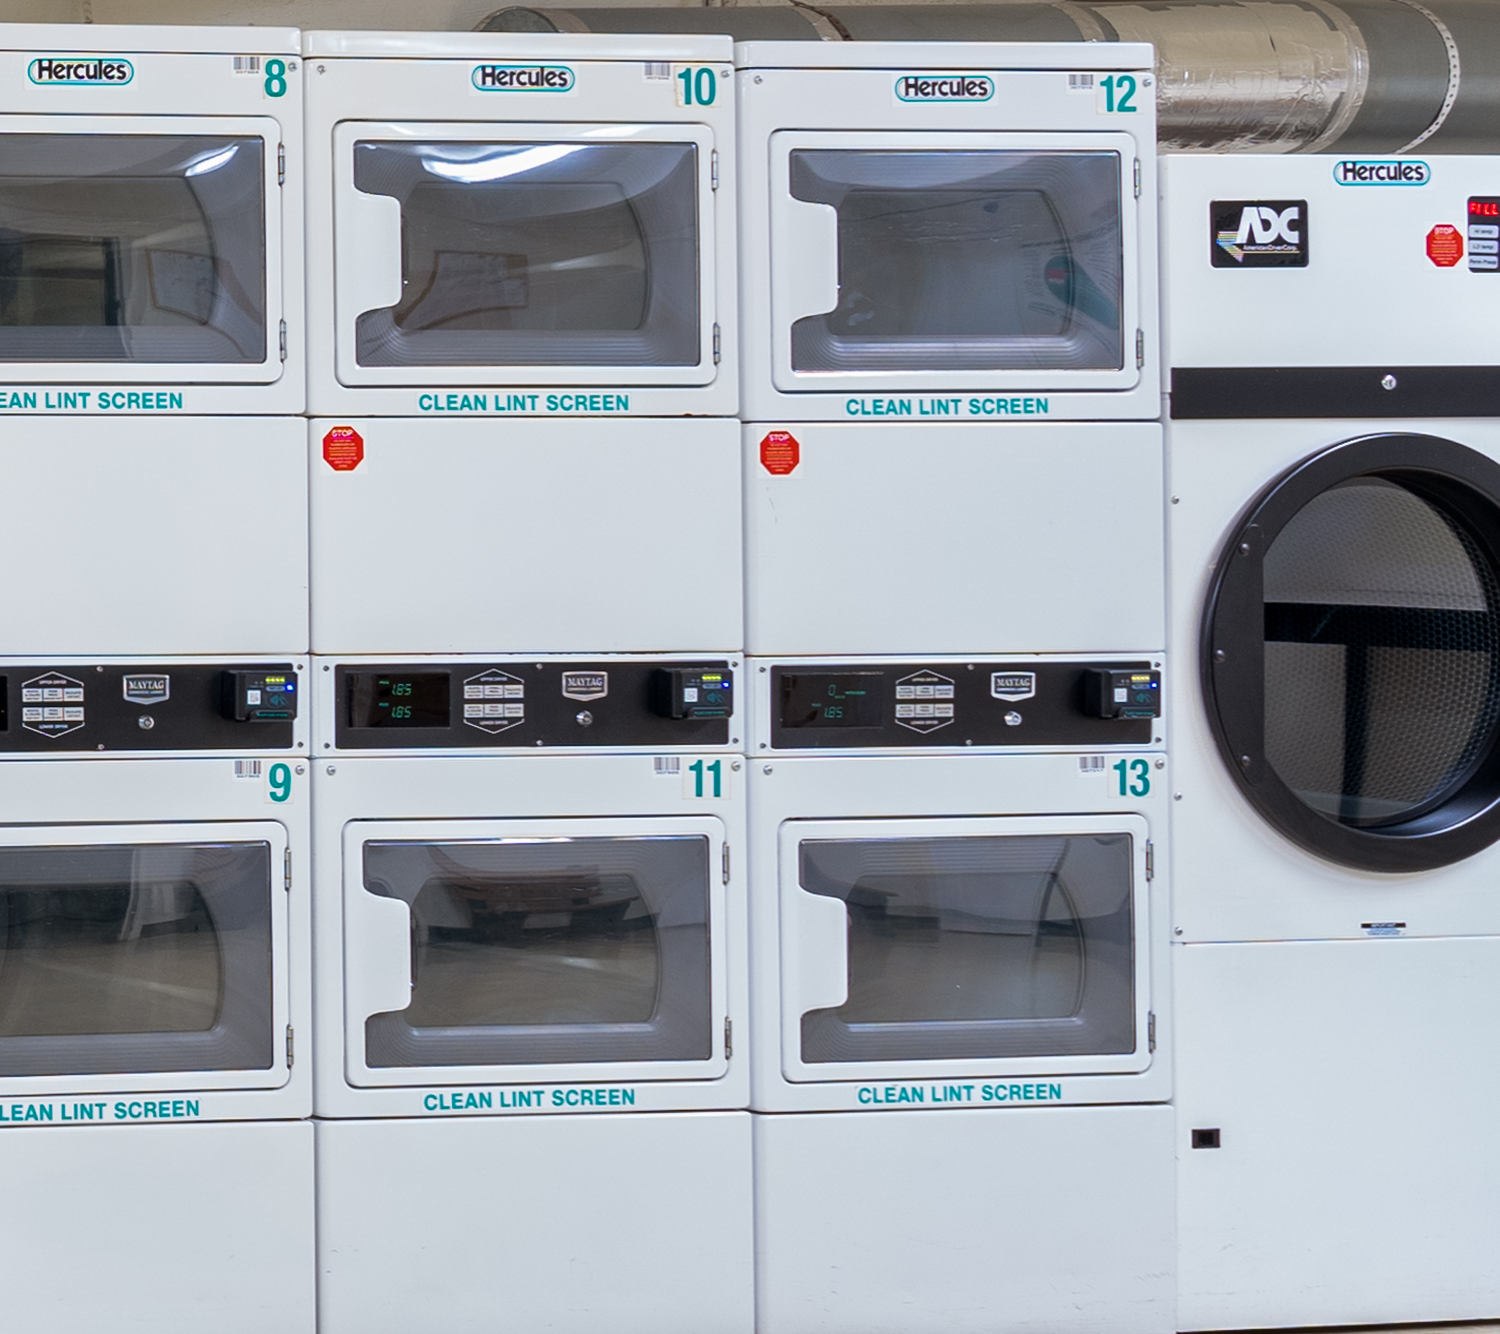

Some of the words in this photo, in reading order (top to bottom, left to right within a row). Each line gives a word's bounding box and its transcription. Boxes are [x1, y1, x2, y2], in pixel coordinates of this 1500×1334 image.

[38, 59, 127, 80] Hercules
[265, 58, 287, 98] 8
[481, 65, 568, 87] Hercules
[678, 67, 716, 106] 10
[904, 76, 988, 97] Hercules
[1100, 75, 1137, 113] 12
[1342, 161, 1424, 181] Hercules
[1235, 206, 1300, 244] ADC
[45, 392, 91, 409] LINT
[98, 392, 183, 410] SCREEN
[418, 394, 487, 411] CLEAN
[494, 394, 539, 411] LINT
[546, 394, 629, 412] SCREEN
[846, 399, 912, 416] CLEAN
[919, 398, 962, 415] LINT
[969, 398, 1049, 415] SCREEN
[331, 429, 354, 437] STOP
[768, 433, 790, 441] STOP
[128, 680, 164, 689] MAYTAG
[567, 677, 603, 686] MAYTAG
[996, 678, 1030, 686] MAYTAG
[269, 762, 292, 803] 9
[688, 759, 721, 798] 11
[1113, 758, 1151, 797] 13
[423, 1092, 492, 1110] CLEAN
[500, 1090, 545, 1108] LINT
[552, 1089, 635, 1107] SCREEN
[857, 1087, 924, 1104] CLEAN
[931, 1085, 975, 1103] LINT
[981, 1084, 1062, 1102] SCREEN
[60, 1103, 107, 1121] LINT
[114, 1101, 200, 1120] SCREEN
